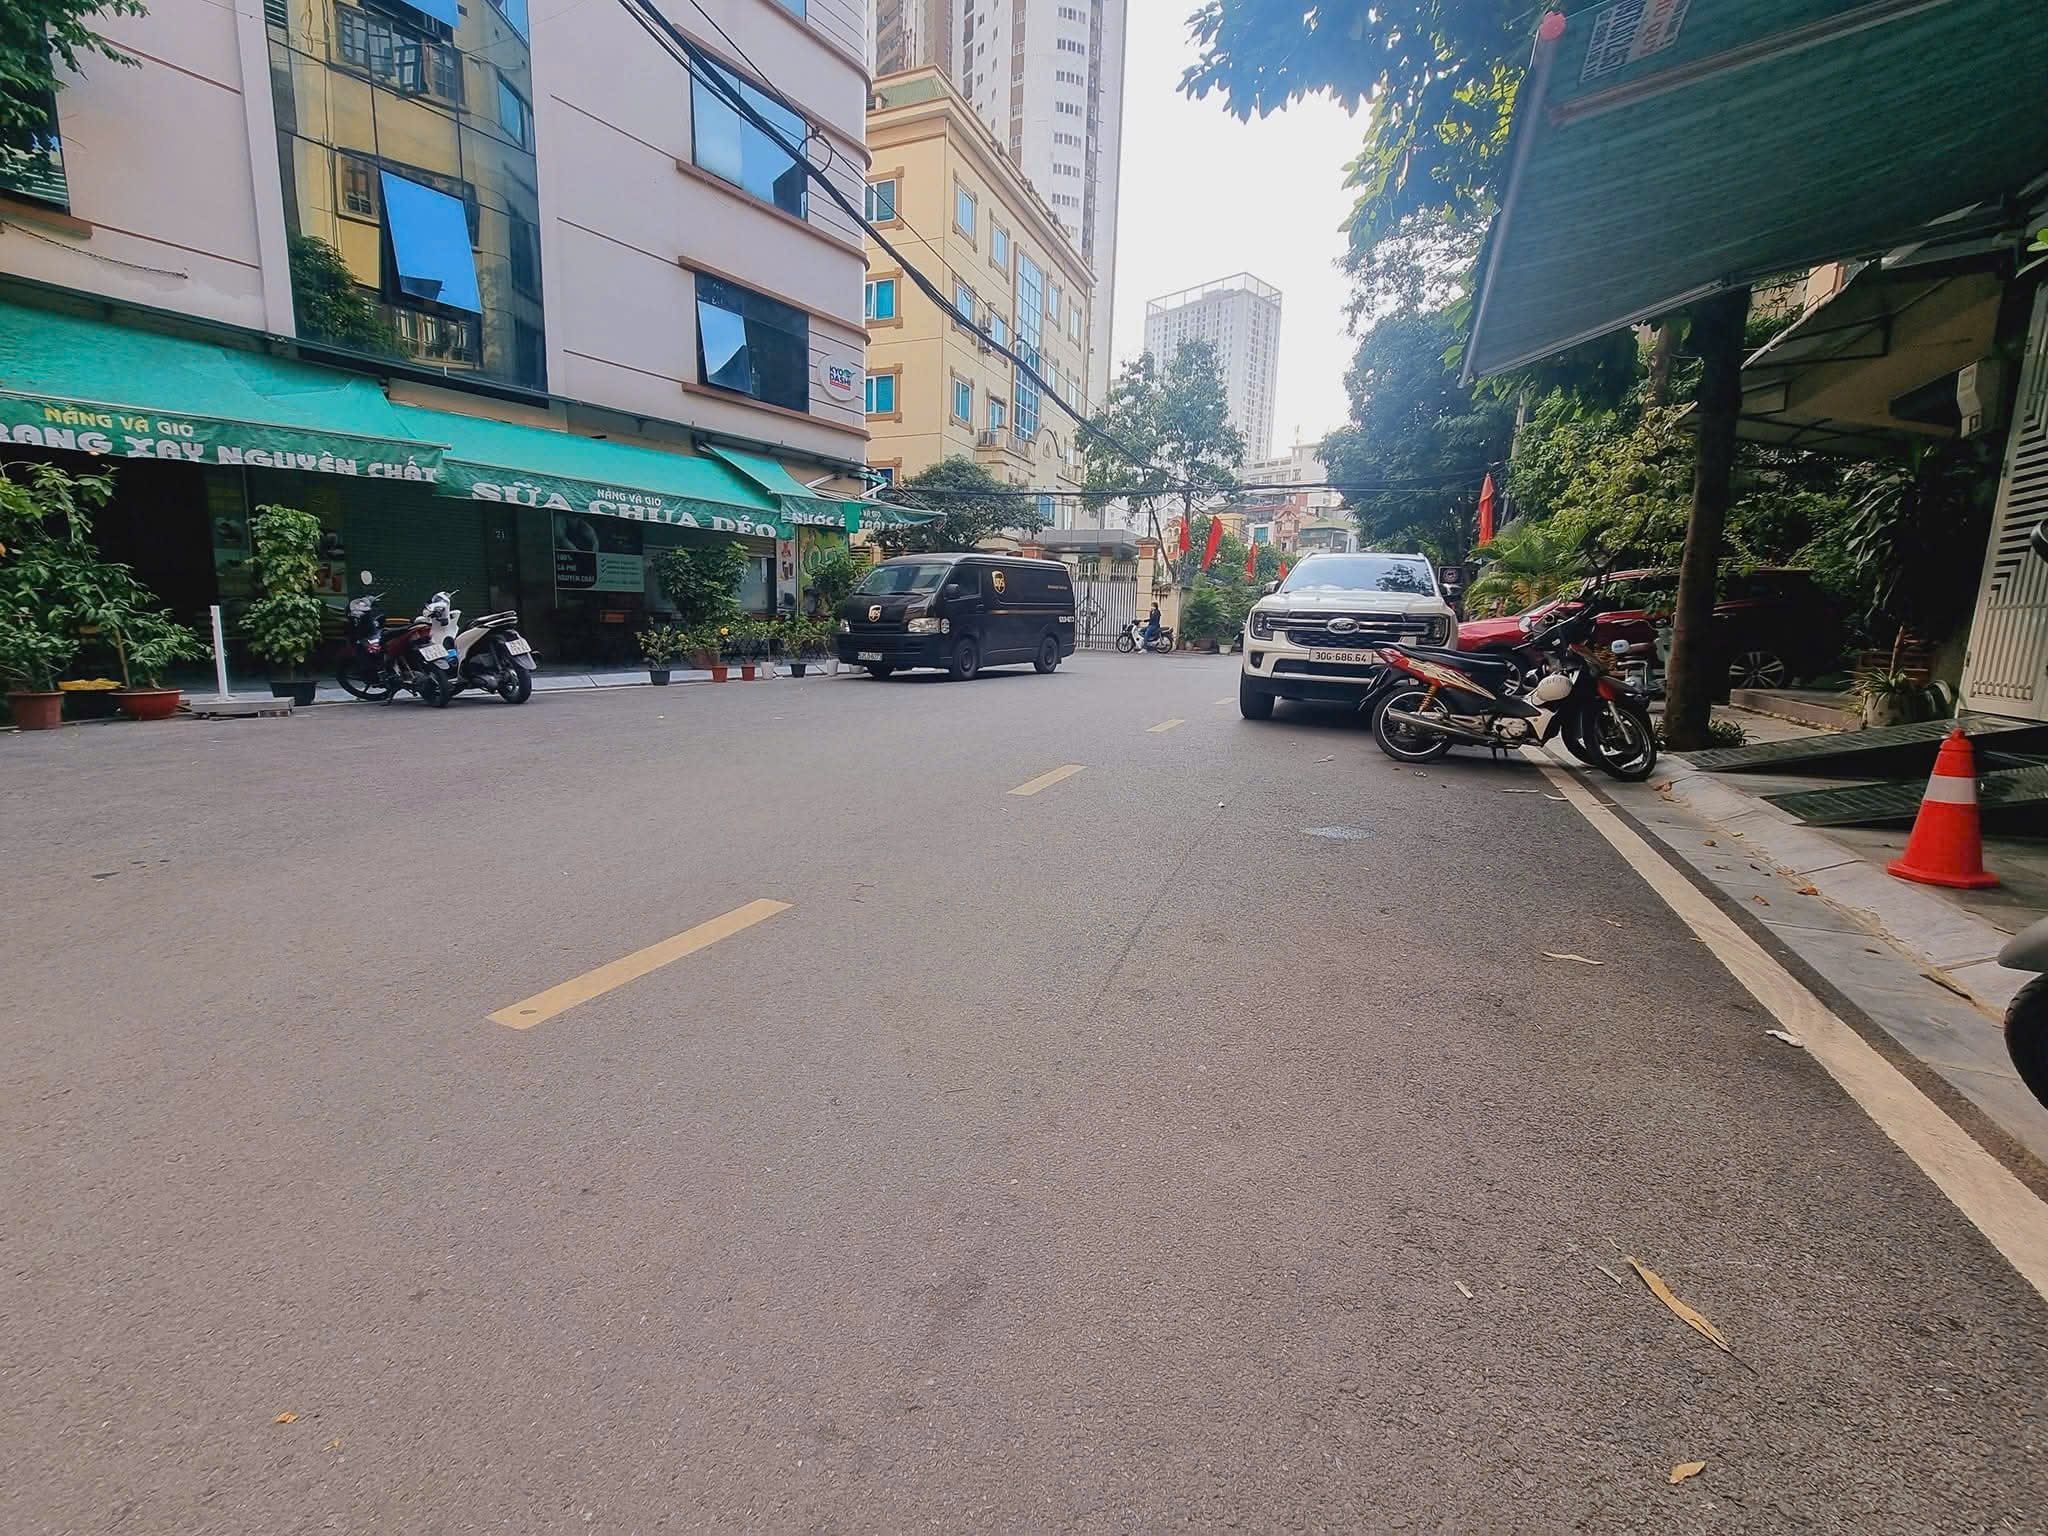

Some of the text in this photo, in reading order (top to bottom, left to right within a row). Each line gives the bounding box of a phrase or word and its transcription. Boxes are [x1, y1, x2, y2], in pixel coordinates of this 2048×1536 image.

[829, 365, 843, 376] KYO
[123, 435, 204, 462] XAY
[217, 445, 357, 475] NGUYÊN
[367, 455, 438, 483] CHẤT
[472, 481, 777, 538] SỮA CHUA DẺO
